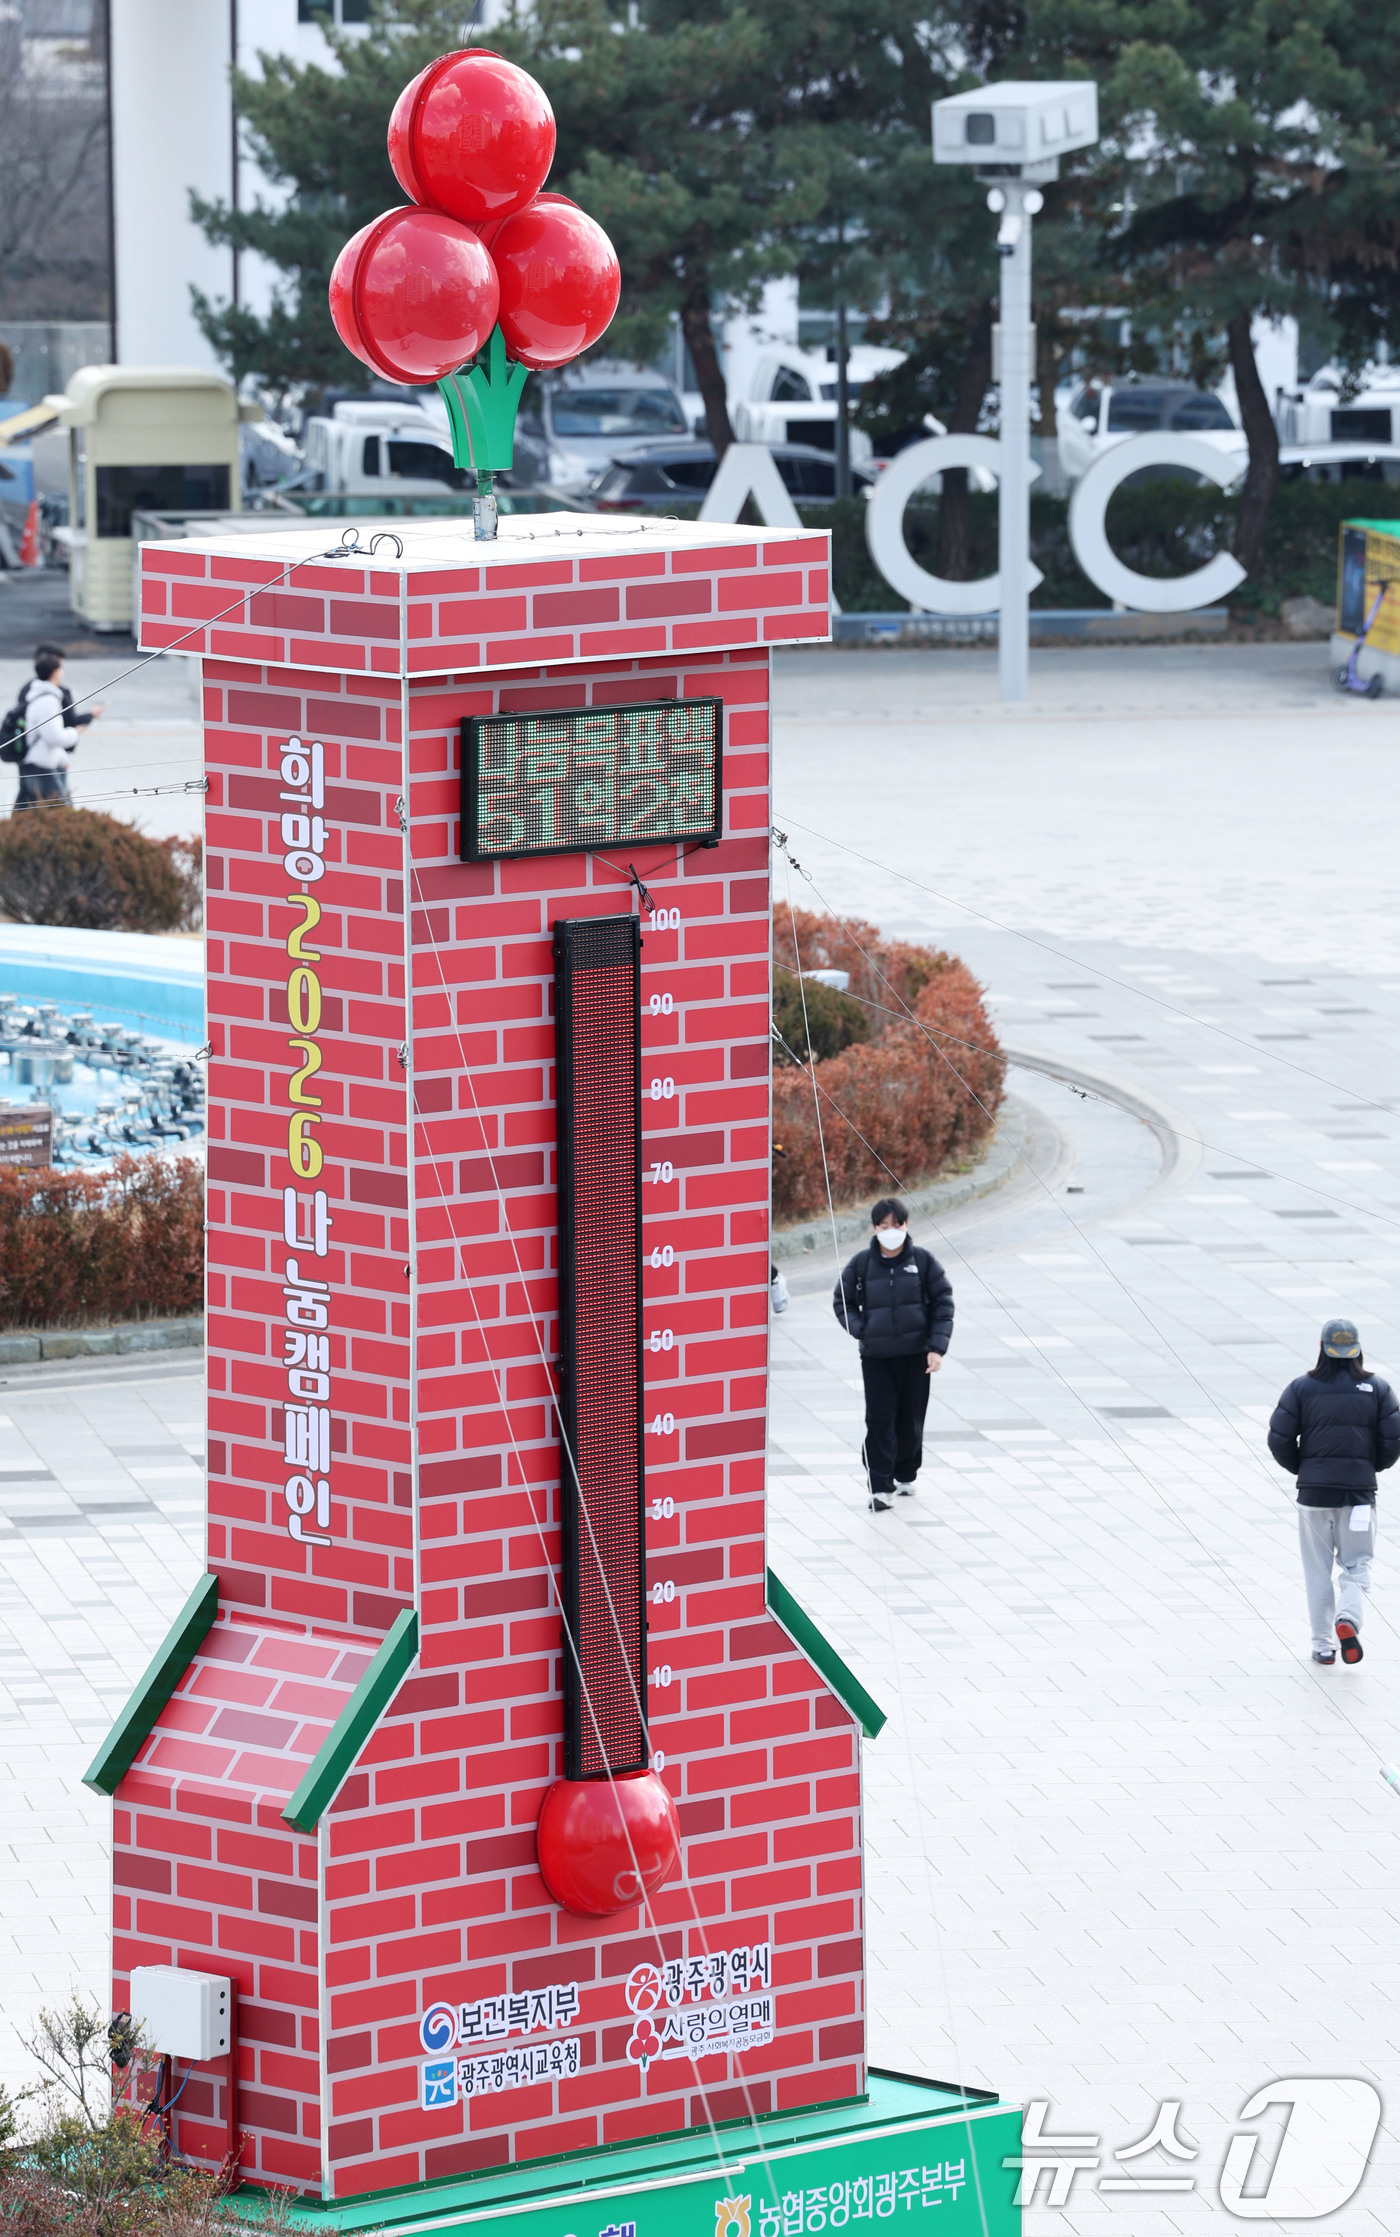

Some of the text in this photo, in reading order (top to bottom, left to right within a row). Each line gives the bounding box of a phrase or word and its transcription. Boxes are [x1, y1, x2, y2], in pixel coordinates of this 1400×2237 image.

[477, 768, 716, 853] 51억2천
[648, 907, 681, 932] 100
[649, 992, 674, 1016] 90
[650, 1077, 675, 1101] 80
[279, 735, 334, 1547] 희망 2026 나눔캠페인
[650, 1161, 673, 1185] 70
[650, 1245, 674, 1269] 60
[650, 1328, 674, 1353] 50
[650, 1412, 675, 1437] 40
[651, 1496, 675, 1521] 30
[652, 1580, 675, 1604] 20
[653, 1664, 673, 1689] 10
[653, 1750, 665, 1773] 0
[665, 1946, 769, 2003] 광주광역시
[461, 1986, 577, 2039] 보건복지부
[664, 1999, 771, 2043] 사랑의열매
[461, 2042, 578, 2094] 광주광역시교육청
[758, 2158, 966, 2237] 농협중앙회광주본부
